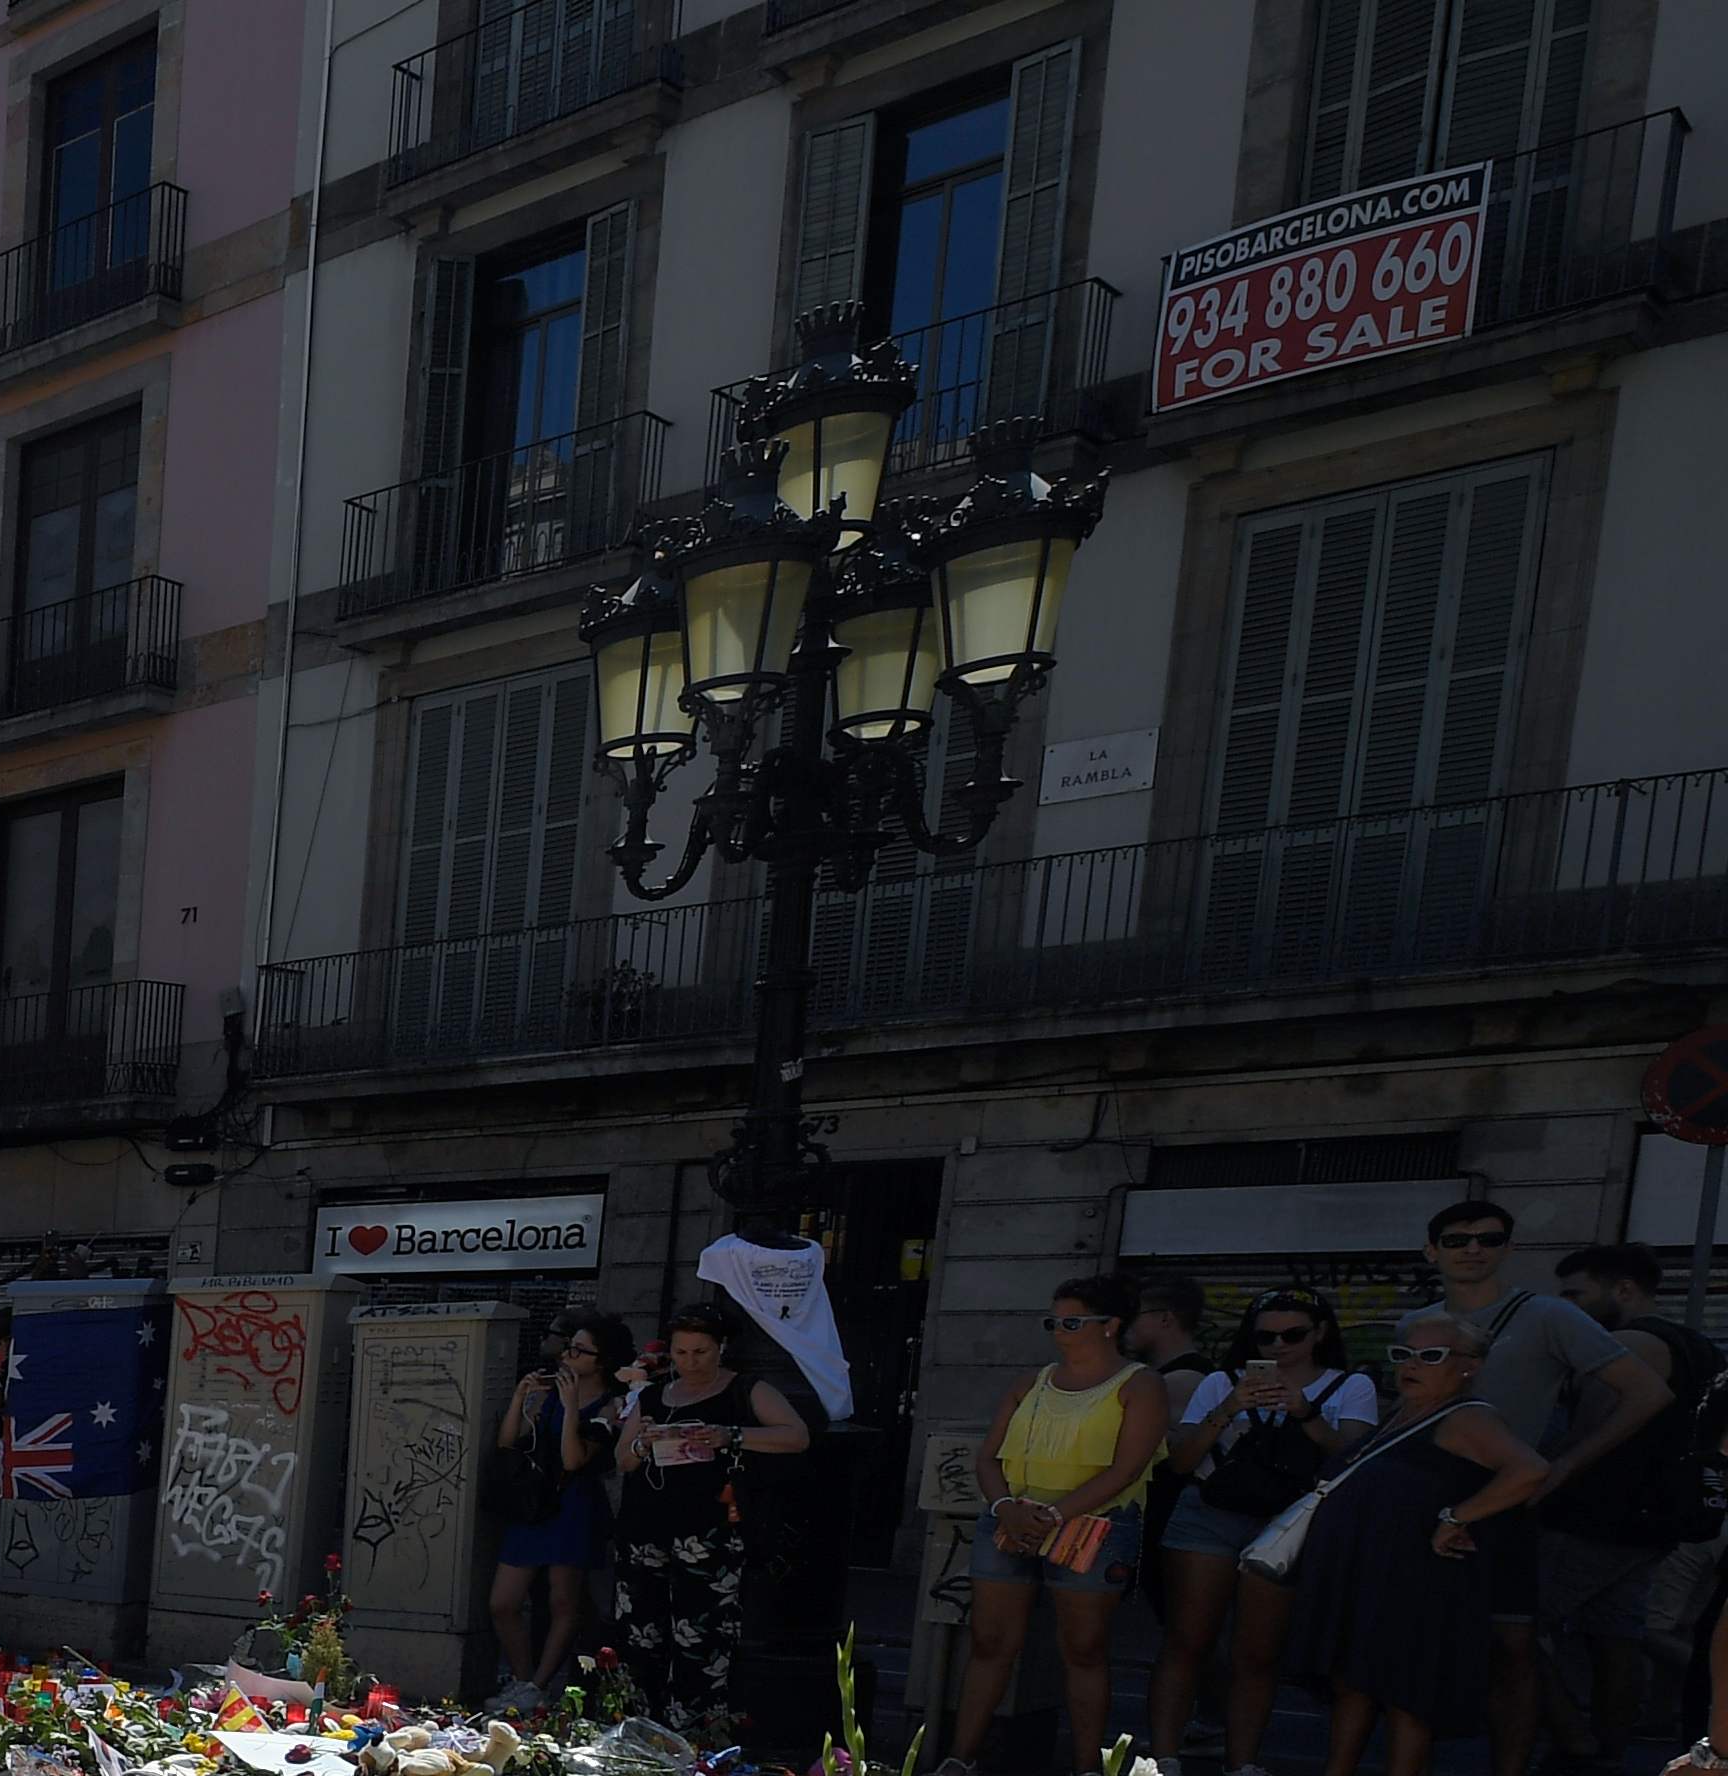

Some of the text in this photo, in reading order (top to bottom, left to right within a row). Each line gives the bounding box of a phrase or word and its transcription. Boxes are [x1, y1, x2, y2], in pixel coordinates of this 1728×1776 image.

[1178, 177, 1471, 284] PISOBARCELONA.COM
[1168, 220, 1474, 356] 934 880 660
[1174, 295, 1450, 399] FOR SALE
[1089, 750, 1108, 761] LA
[1061, 767, 1133, 788] RAMBLA
[181, 906, 197, 925] 71
[324, 1218, 589, 1259] I Barcelona
